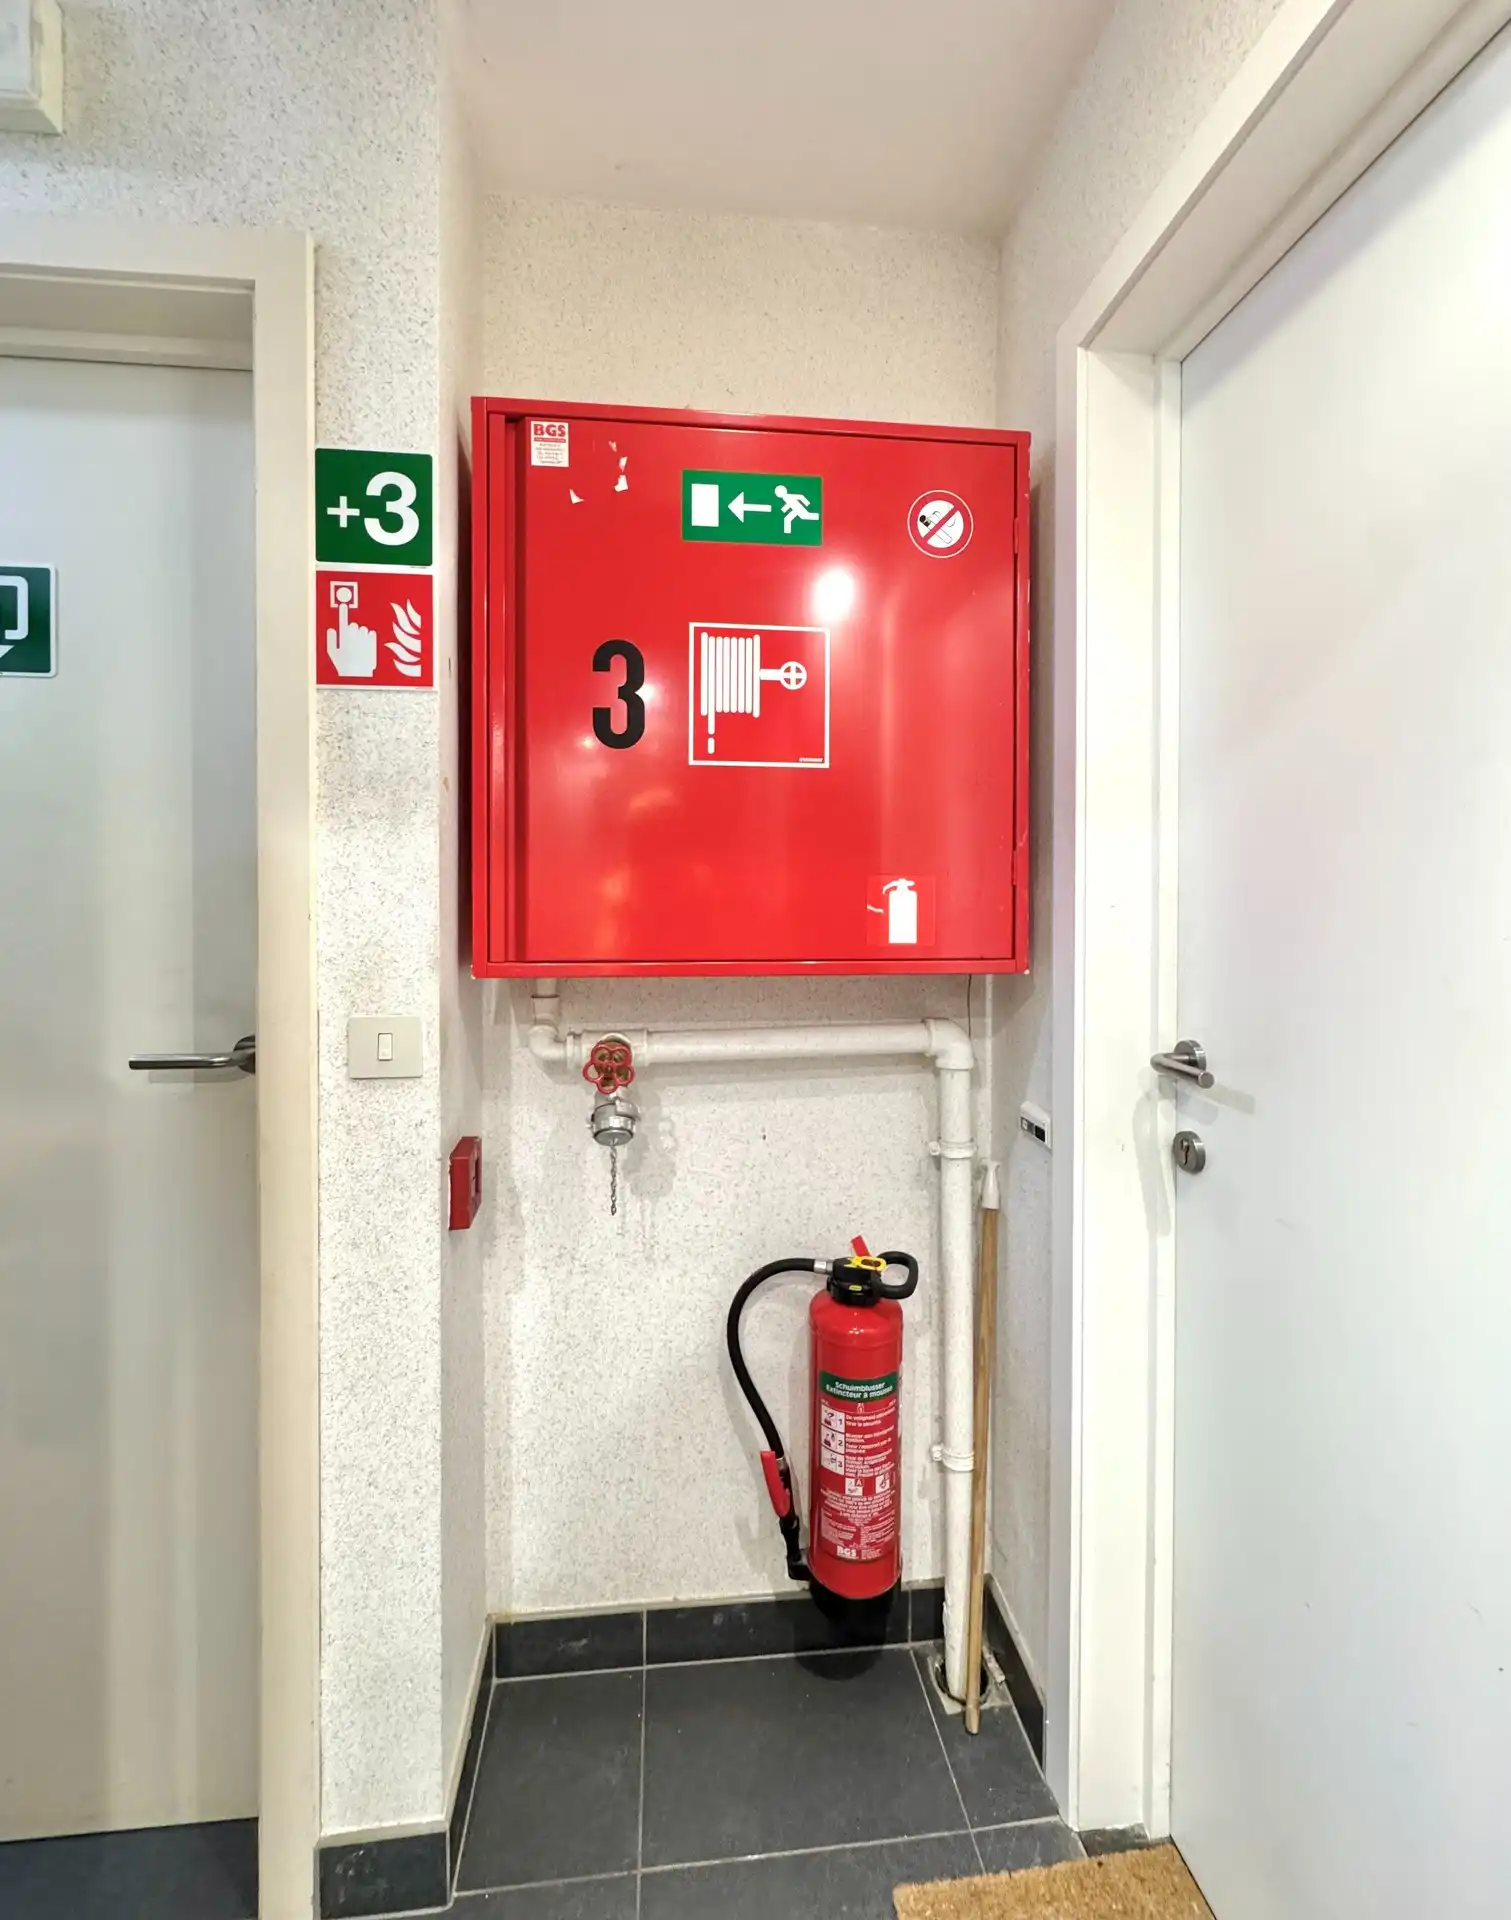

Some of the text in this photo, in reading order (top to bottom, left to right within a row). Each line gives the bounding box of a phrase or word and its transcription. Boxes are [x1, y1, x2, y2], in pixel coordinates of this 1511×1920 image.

[534, 424, 566, 437] BGS
[327, 471, 419, 546] +3
[592, 639, 645, 749] 3
[826, 1384, 861, 1398] Extincteur
[869, 1385, 893, 1398] mousse
[835, 1381, 885, 1392] Schuimblusser
